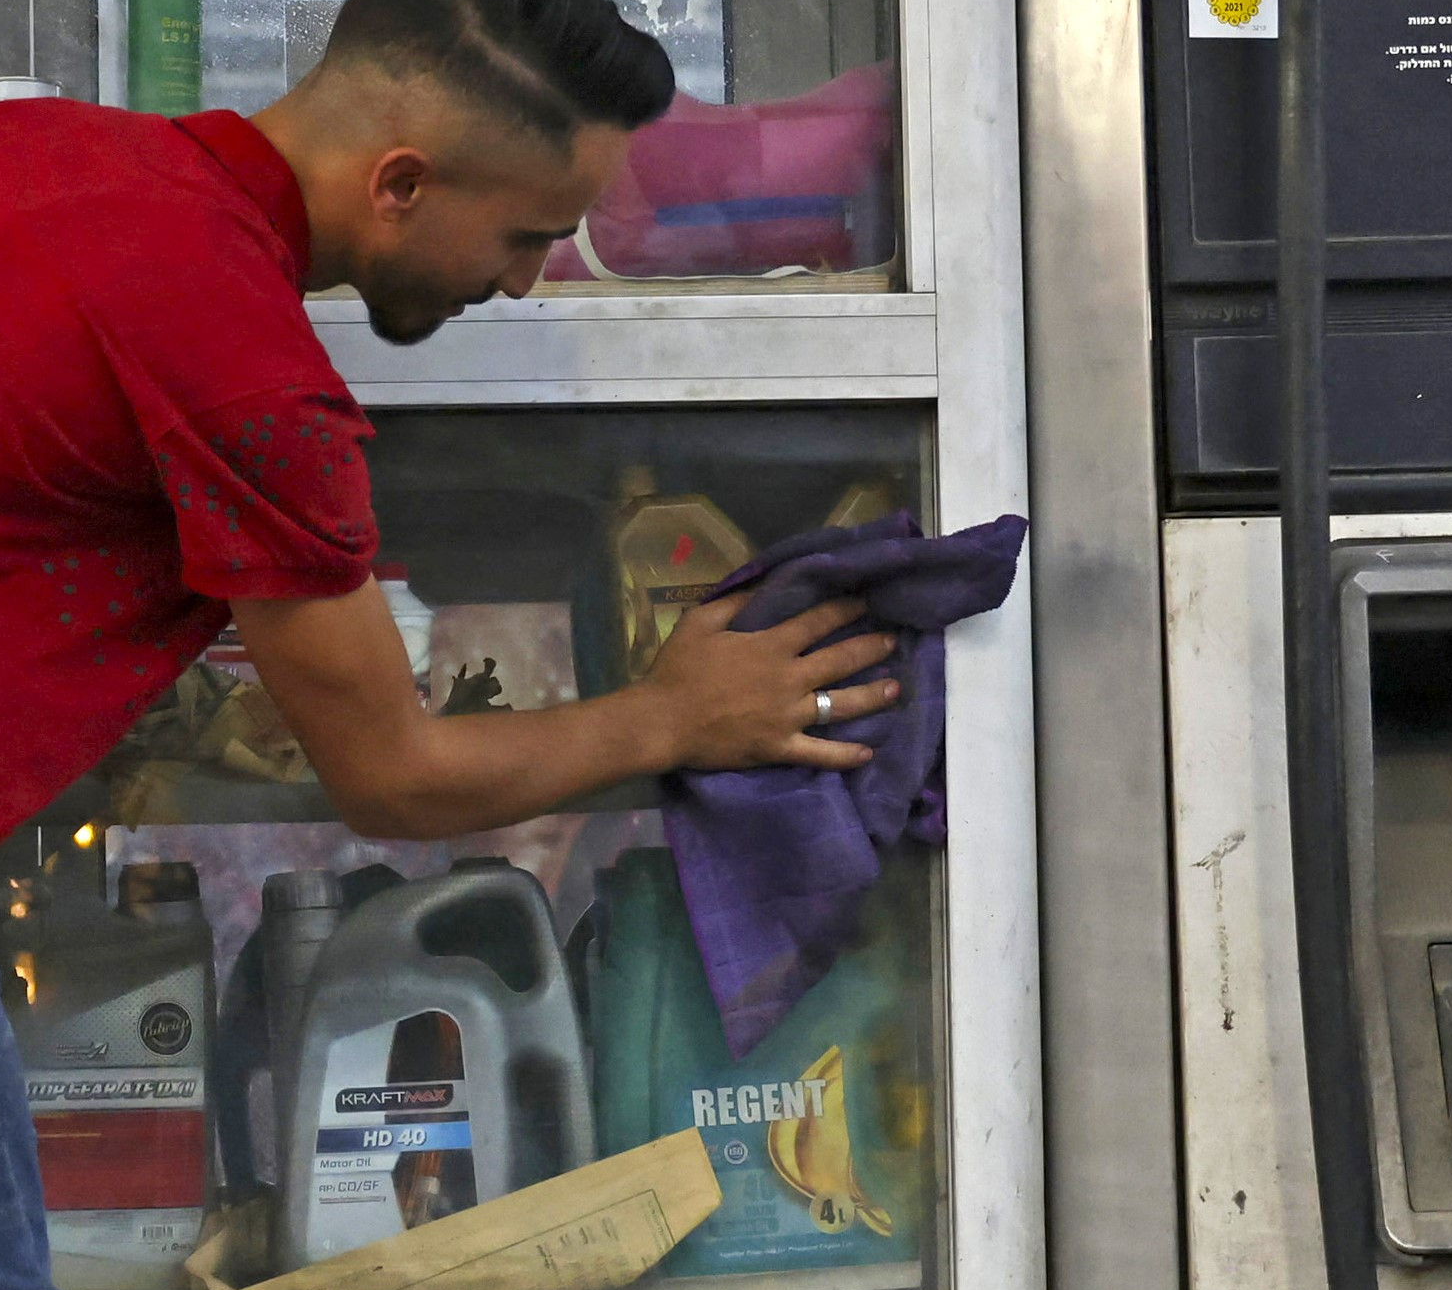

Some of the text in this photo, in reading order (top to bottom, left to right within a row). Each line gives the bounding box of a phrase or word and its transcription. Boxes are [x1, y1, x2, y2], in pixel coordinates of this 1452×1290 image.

[1224, 2, 1243, 12] 2021
[341, 1088, 447, 1106] KRAFTMAX
[691, 1078, 827, 1127] REGENT
[363, 1129, 427, 1148] HD 40
[319, 1157, 372, 1169] Motor Oil
